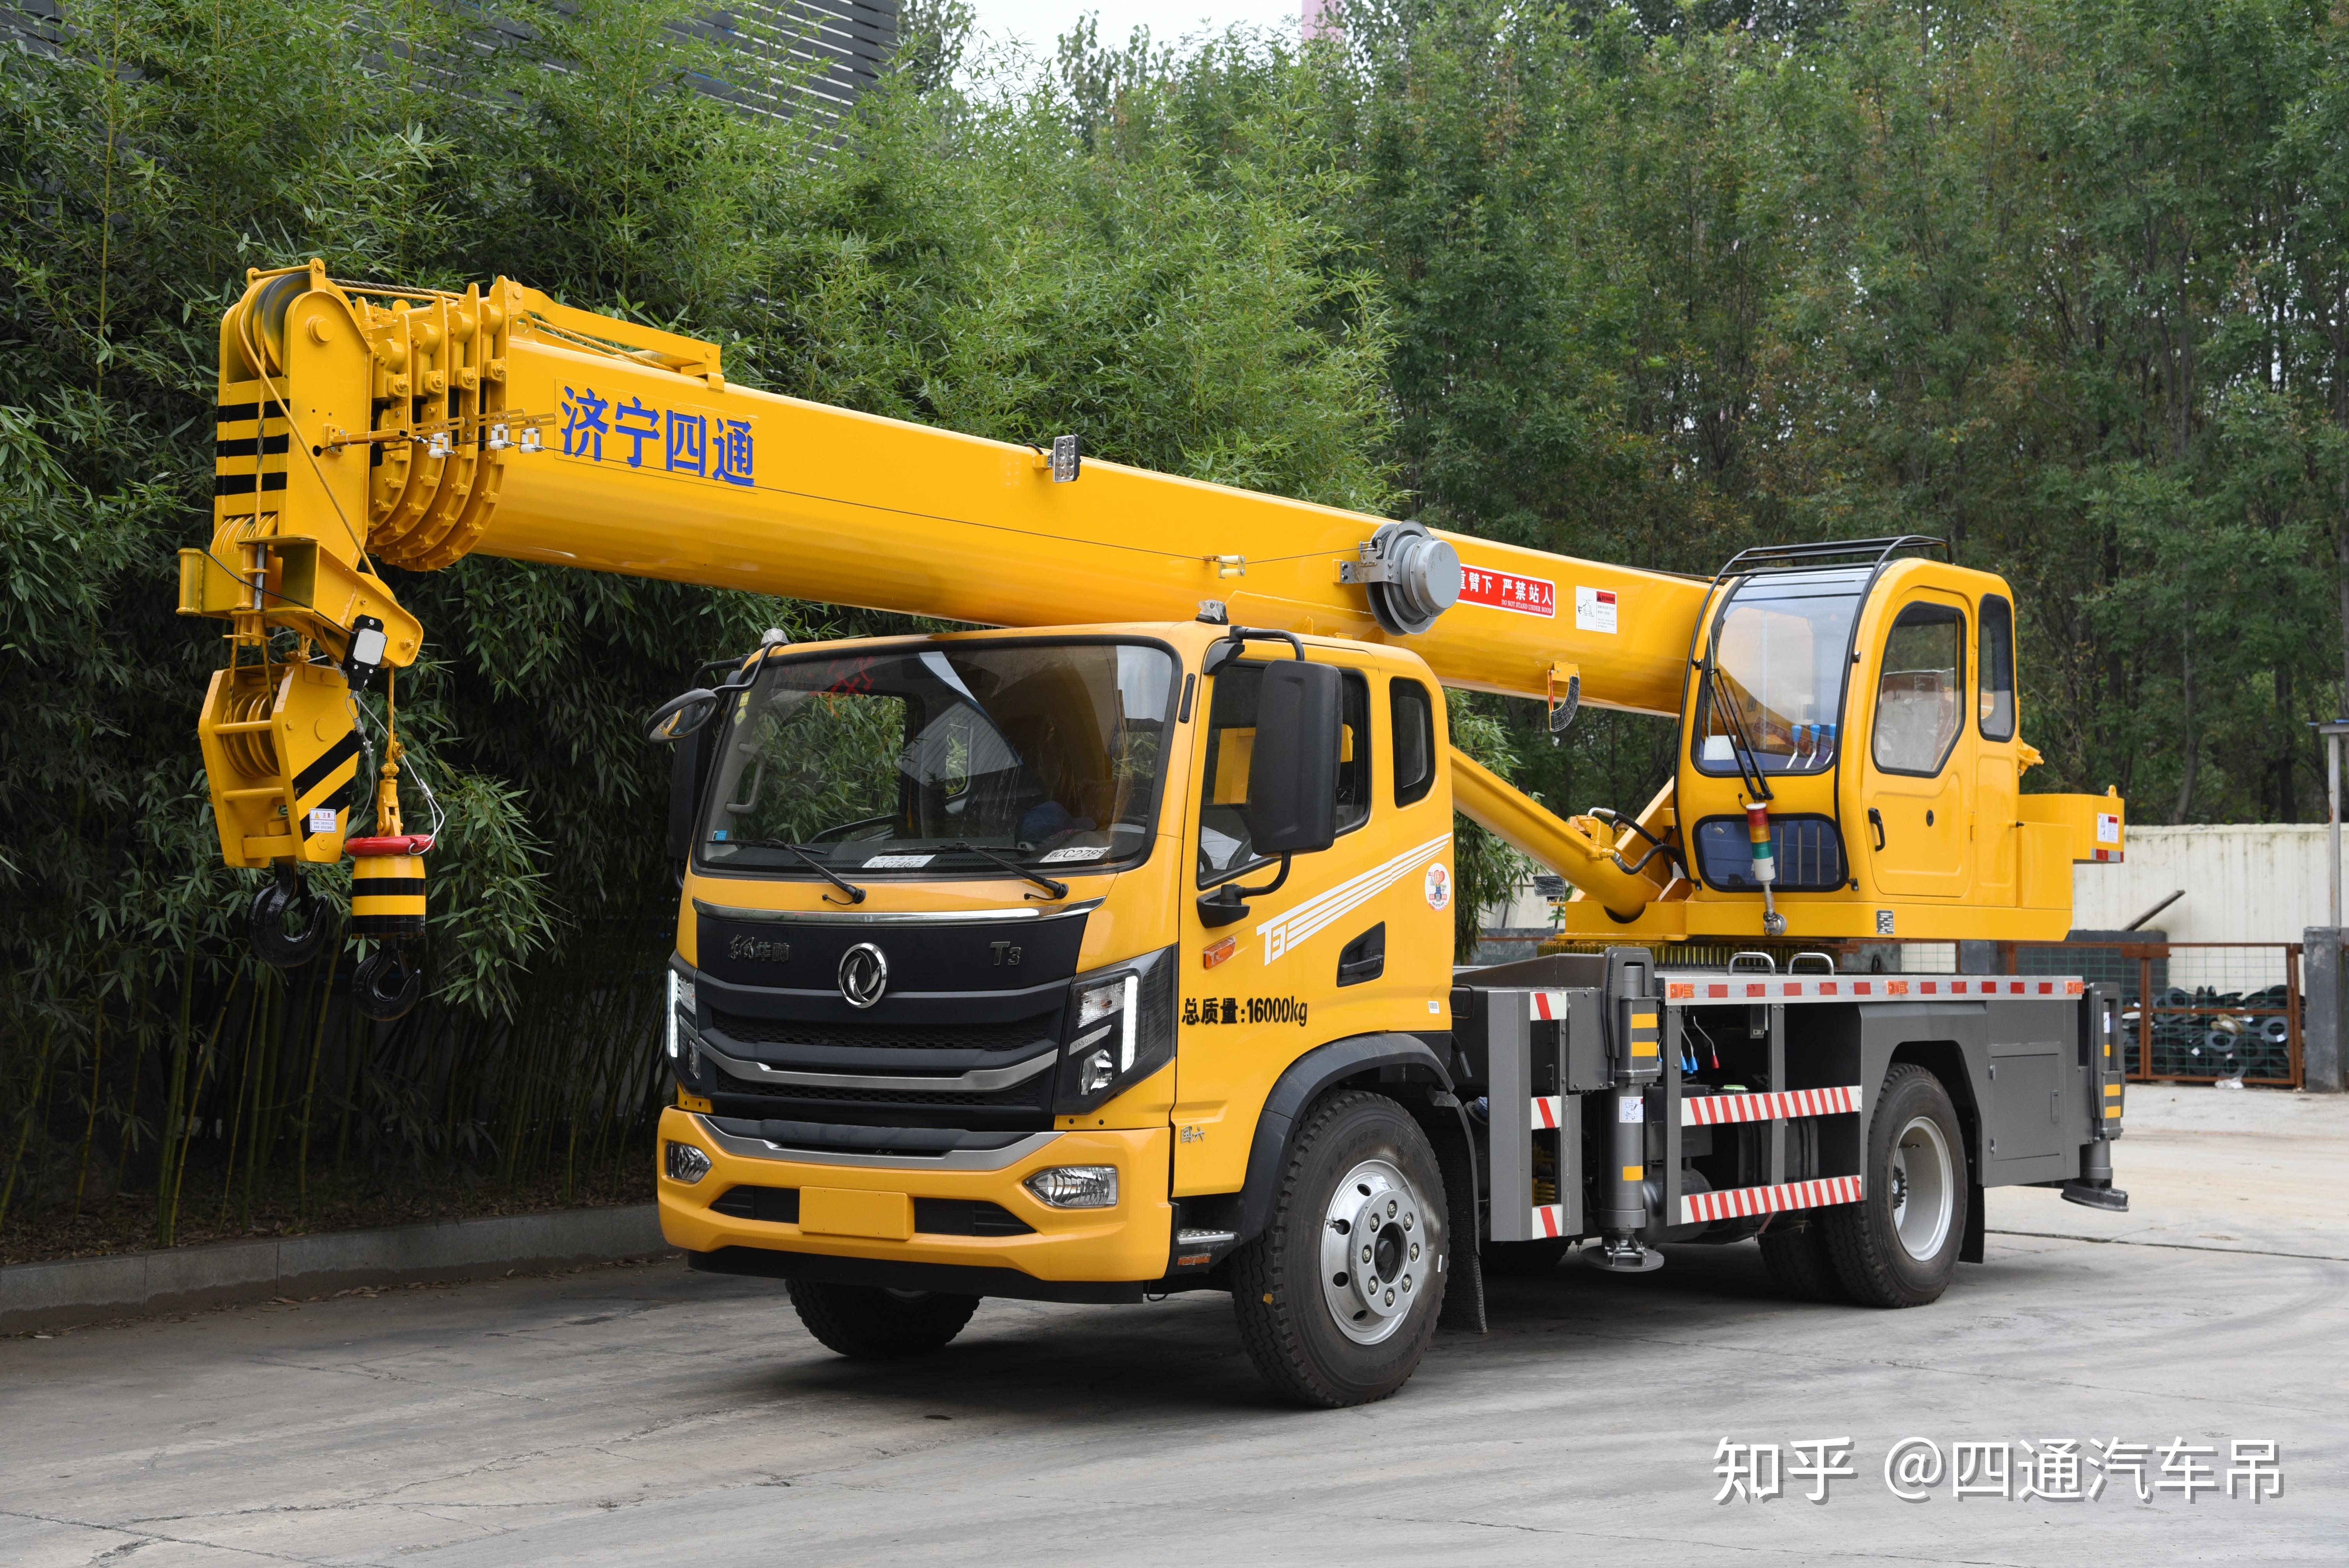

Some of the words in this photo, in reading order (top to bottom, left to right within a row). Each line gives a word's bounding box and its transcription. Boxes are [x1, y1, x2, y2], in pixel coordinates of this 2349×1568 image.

[560, 385, 754, 487] 济宁四通
[1502, 578, 1552, 606] 严禁站人
[989, 941, 1021, 966] T3
[1073, 1037, 1092, 1048] VASOL
[1180, 1124, 1206, 1144] 国六
